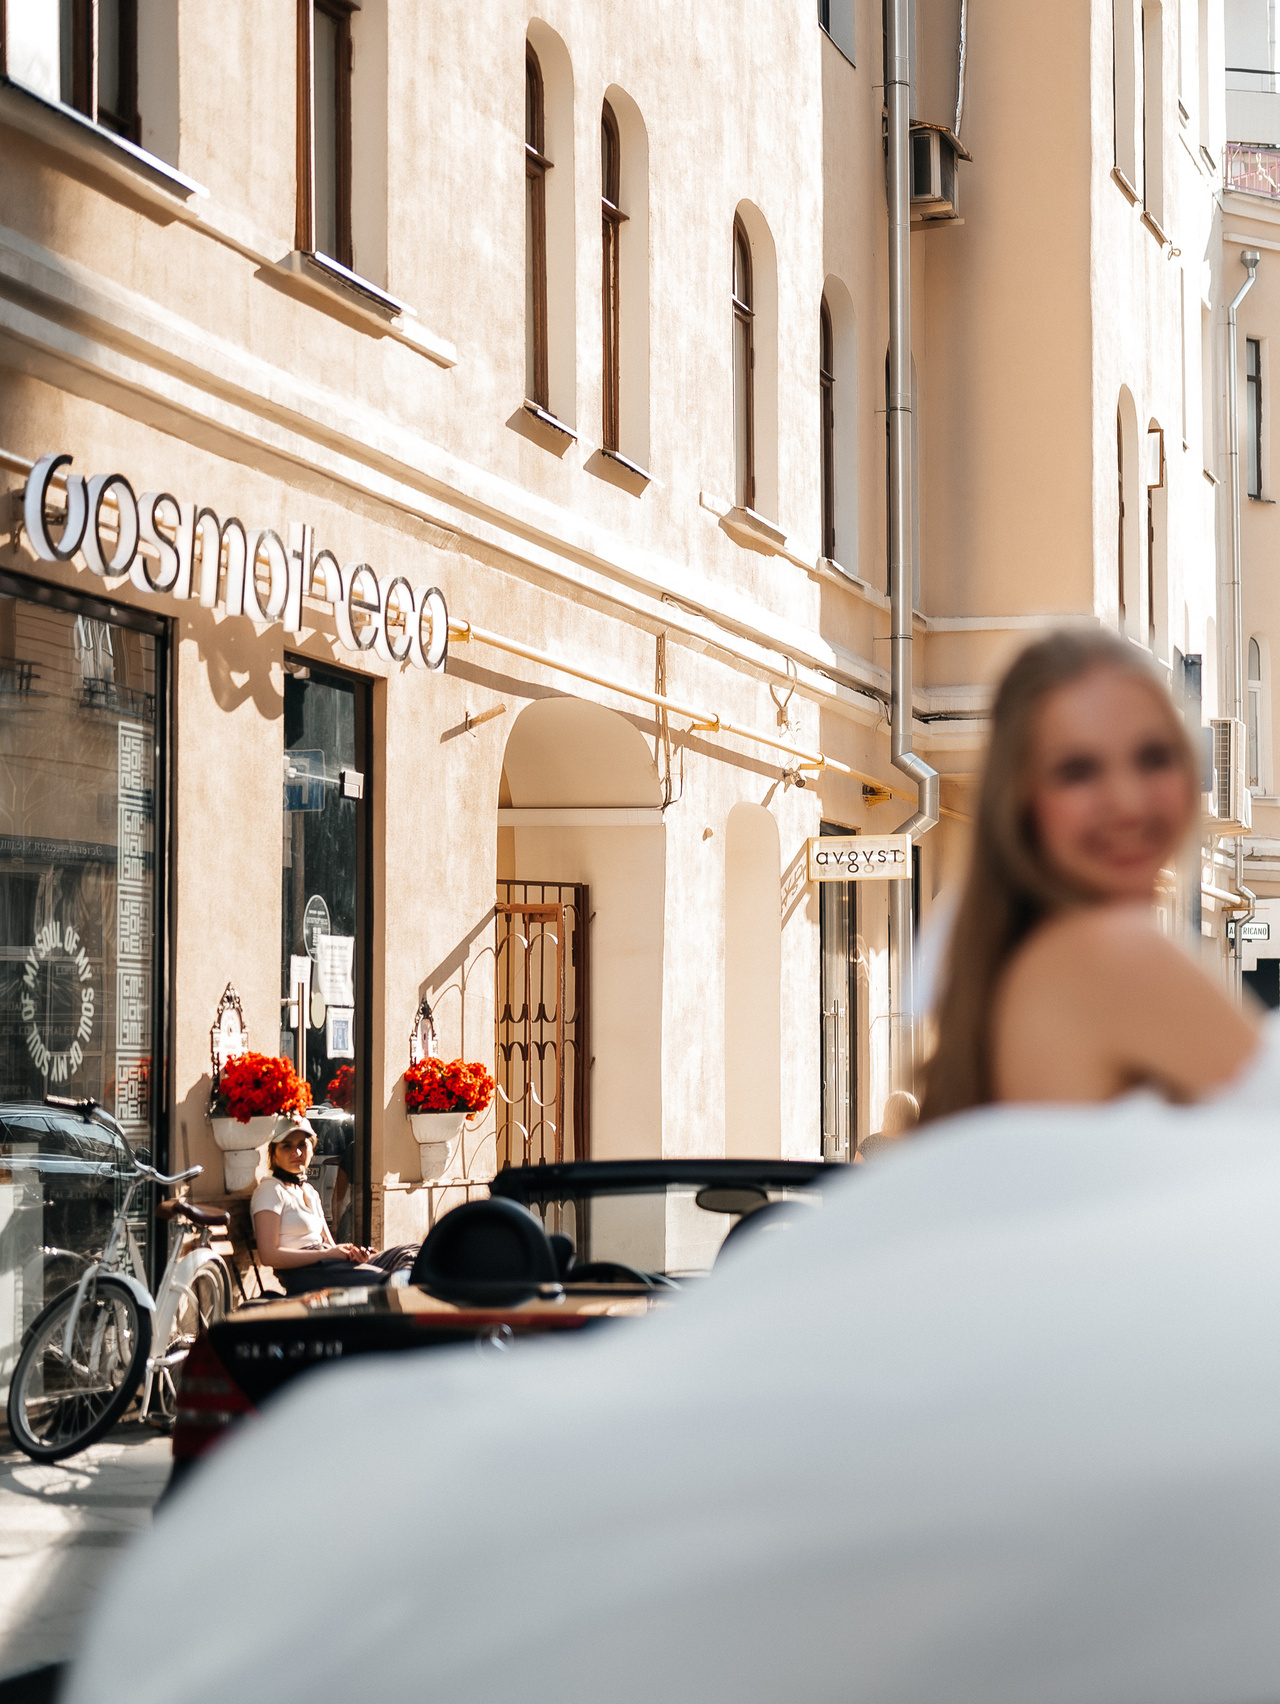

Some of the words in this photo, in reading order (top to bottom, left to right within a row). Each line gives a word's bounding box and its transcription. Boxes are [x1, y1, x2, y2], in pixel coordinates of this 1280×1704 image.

[35, 921, 63, 958] SOUL
[64, 926, 80, 955] OF
[1229, 926, 1267, 935] ARICANO
[23, 948, 40, 988] MY
[75, 946, 92, 982] MY
[21, 991, 35, 1022] OF
[77, 987, 94, 1043] SOUL
[26, 1022, 51, 1076] SOUL
[69, 1040, 83, 1074] OF
[50, 1054, 68, 1083] MY
